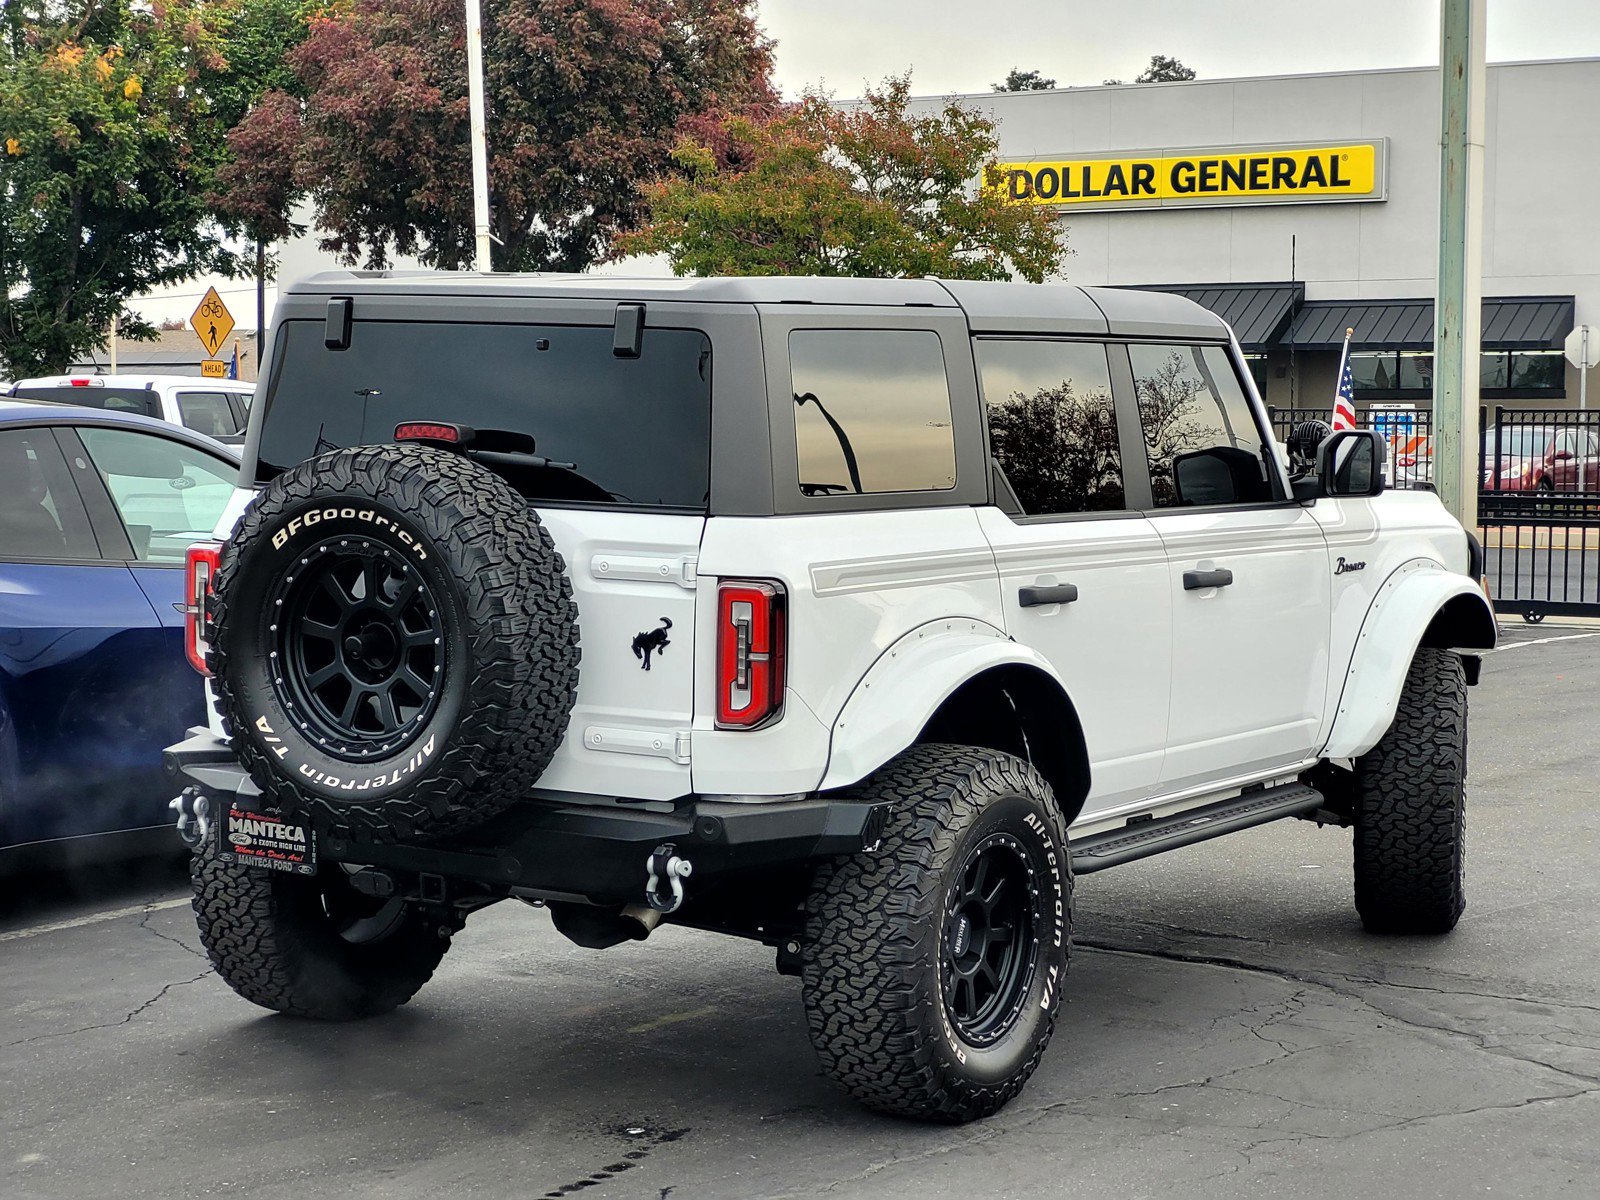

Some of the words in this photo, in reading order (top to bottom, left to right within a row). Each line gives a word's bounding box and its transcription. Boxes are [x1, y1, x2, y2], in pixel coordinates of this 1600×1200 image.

[1010, 163, 1156, 199] DOLLAR
[1170, 154, 1351, 193] GENERAL
[204, 365, 221, 373] AHEAD
[271, 508, 428, 560] BFGoodrich
[1334, 557, 1367, 575] Bronco
[255, 715, 290, 760] T/A
[299, 734, 435, 790] All-Terrain
[229, 817, 305, 842] MANTECA
[258, 839, 278, 848] EXOTIC
[279, 842, 293, 850] HIGH
[294, 844, 306, 852] LINE
[238, 854, 272, 868] MANTECA
[273, 859, 293, 871] FORD
[1023, 812, 1063, 947] All-Terrain
[1040, 965, 1059, 1011] T/A
